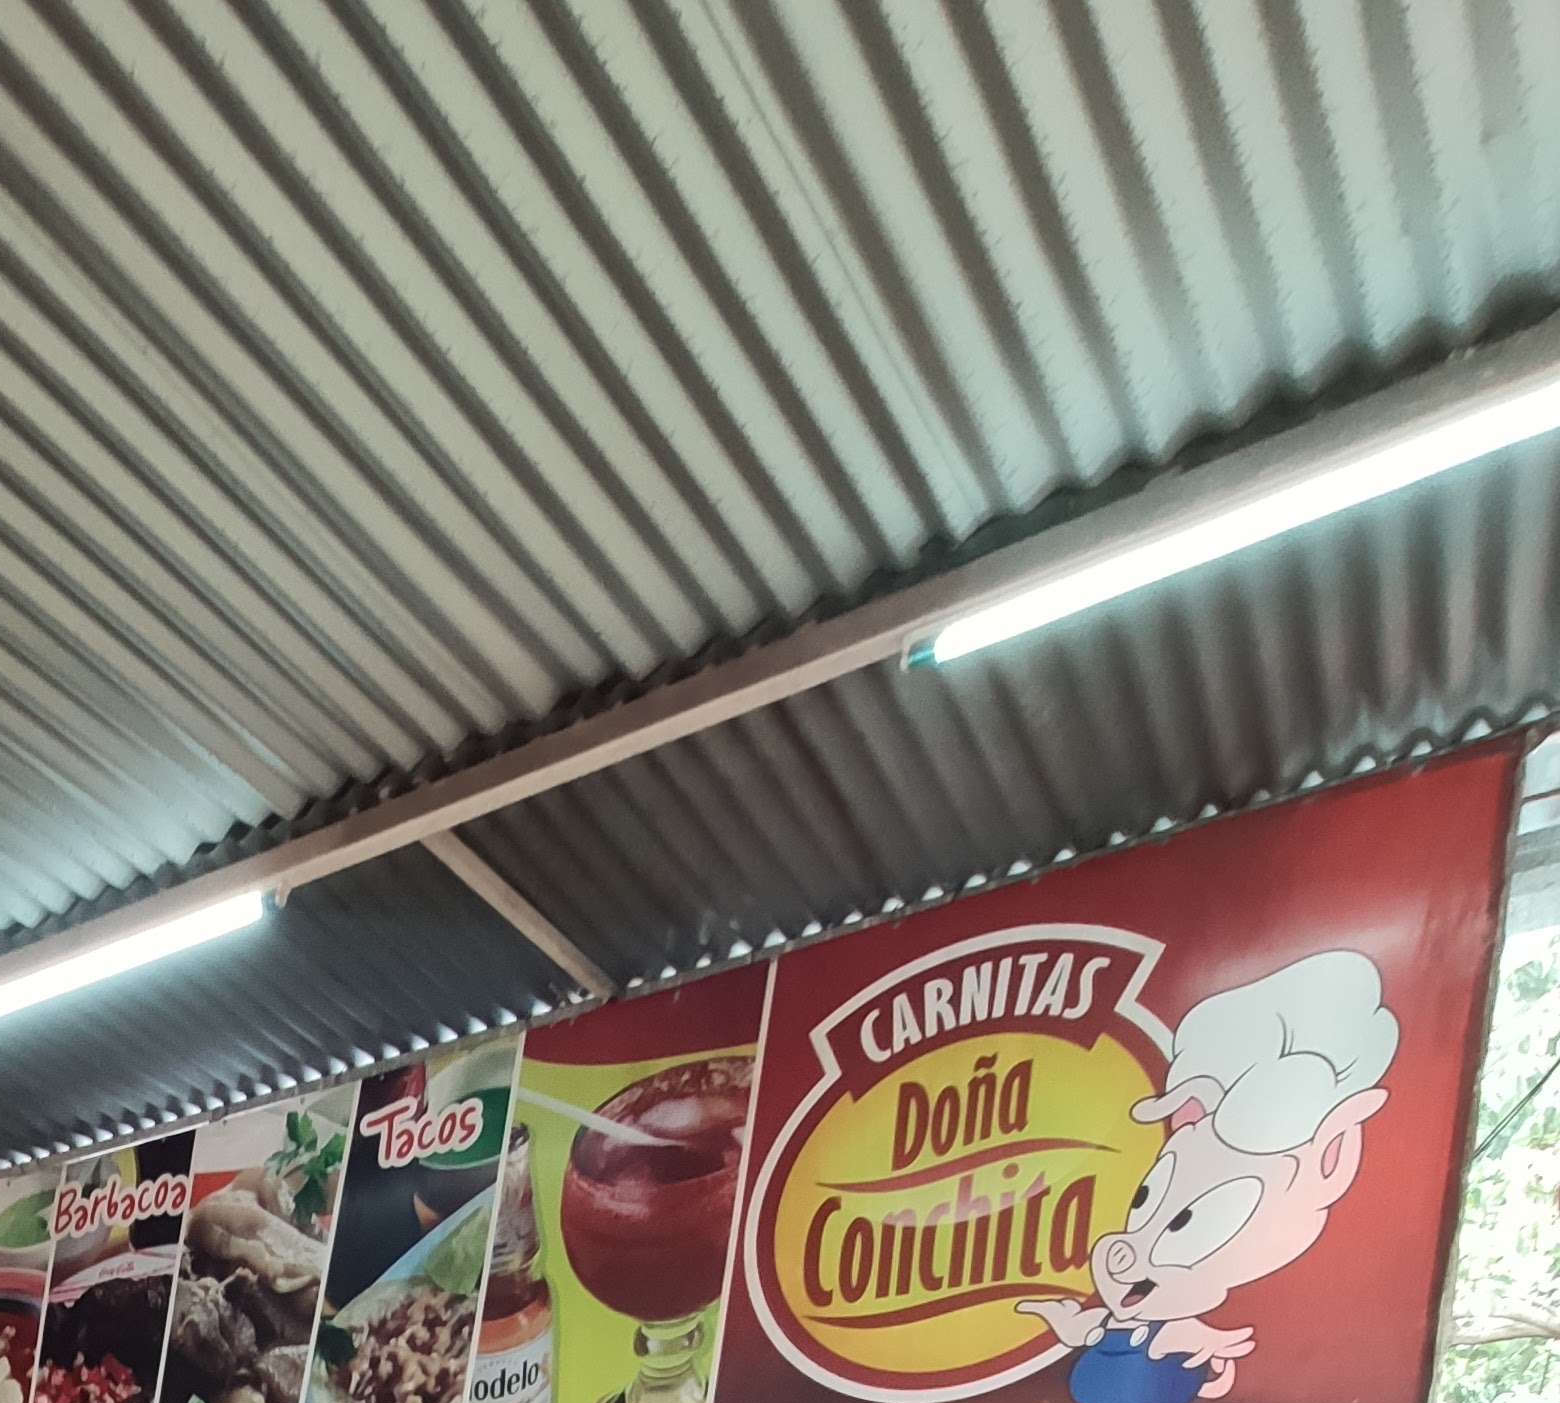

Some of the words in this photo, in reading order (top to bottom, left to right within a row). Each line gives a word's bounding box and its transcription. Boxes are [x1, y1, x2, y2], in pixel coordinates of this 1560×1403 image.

[859, 951, 1112, 1064] CARNITAS
[367, 1103, 477, 1162] Tacos
[892, 1053, 1034, 1172] Doña
[54, 1179, 188, 1235] Barbacoa
[803, 1162, 1100, 1309] Conchita
[469, 1359, 540, 1402] odelo
